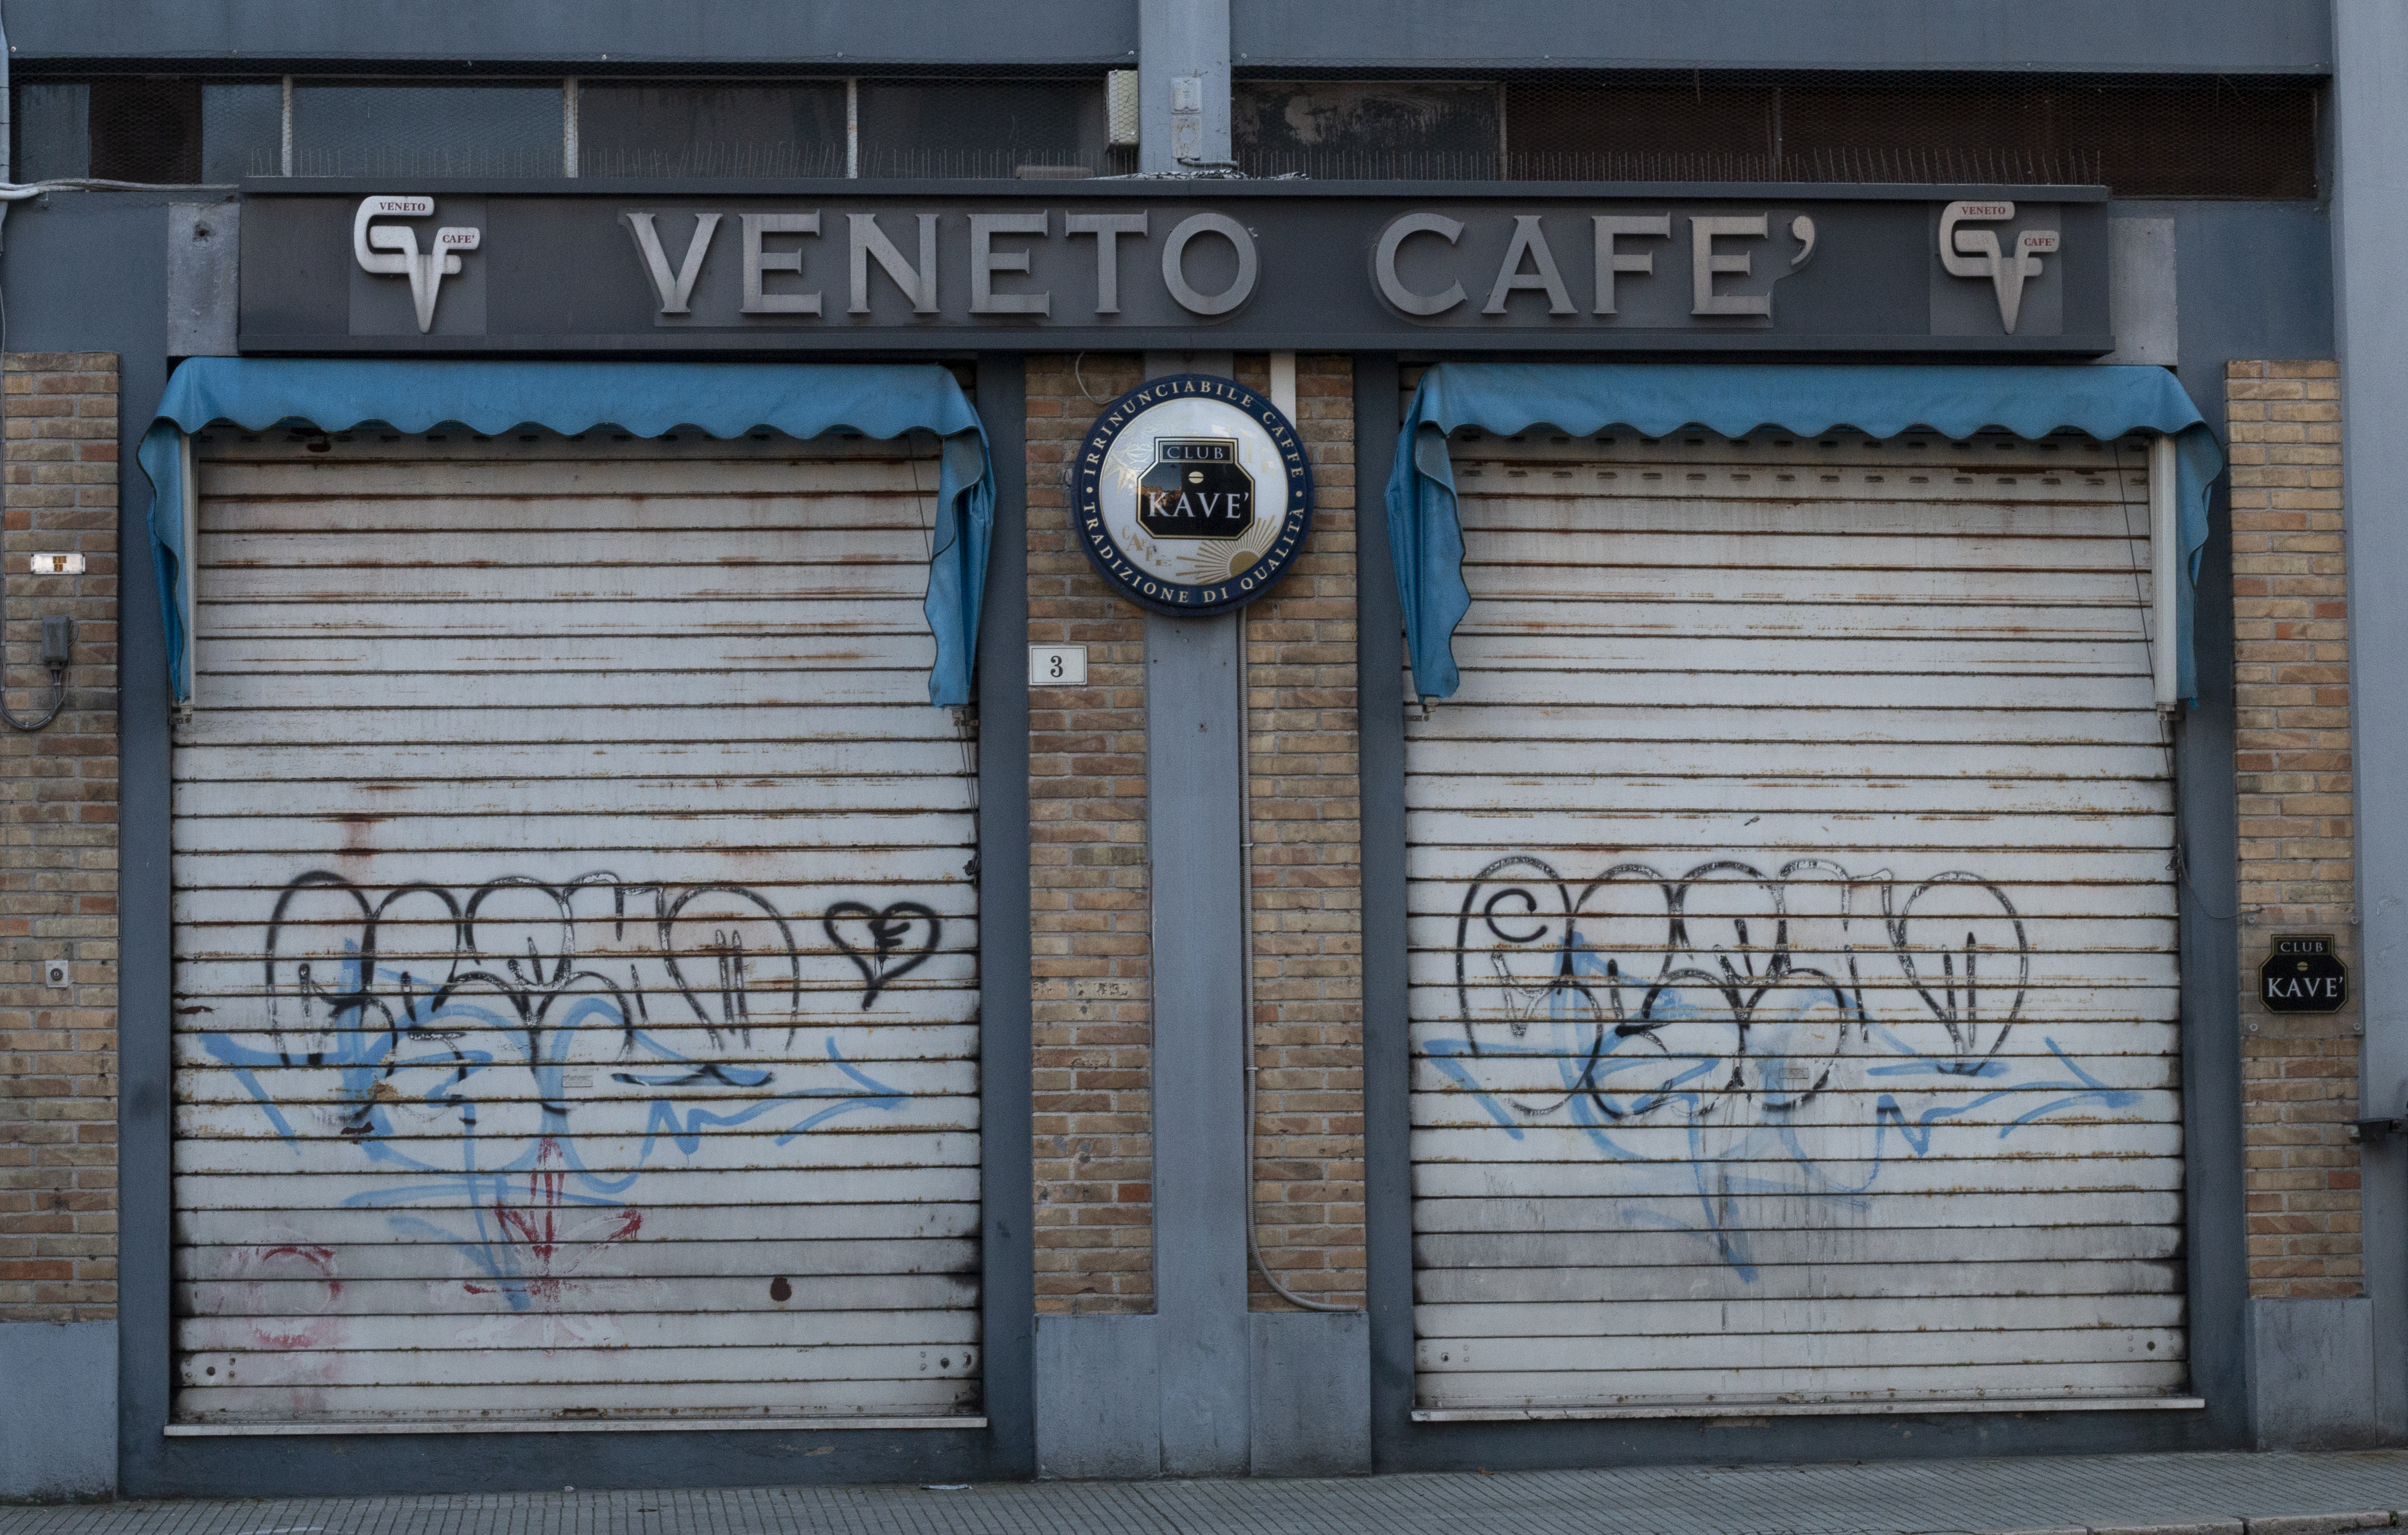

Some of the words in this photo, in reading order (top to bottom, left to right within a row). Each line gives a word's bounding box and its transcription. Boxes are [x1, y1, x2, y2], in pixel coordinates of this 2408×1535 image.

[379, 202, 426, 212] VENETO
[1961, 206, 2006, 215] VENETO
[442, 234, 475, 244] CAFE'
[2023, 238, 2055, 247] CAFE'
[626, 209, 1258, 317] VENETO
[1375, 211, 1816, 319] CAFE'
[1084, 381, 1254, 475] IRRINUNCIABILE
[1167, 446, 1224, 460] CLUB
[1147, 491, 1249, 519] KAVE'
[1083, 502, 1189, 603] TRADIZIONE
[1203, 587, 1229, 603] DI
[1240, 507, 1305, 590] QUALITÀ
[1050, 655, 1063, 678] 3
[2280, 942, 2323, 953] CLUB
[2268, 976, 2343, 998] KAVE'
